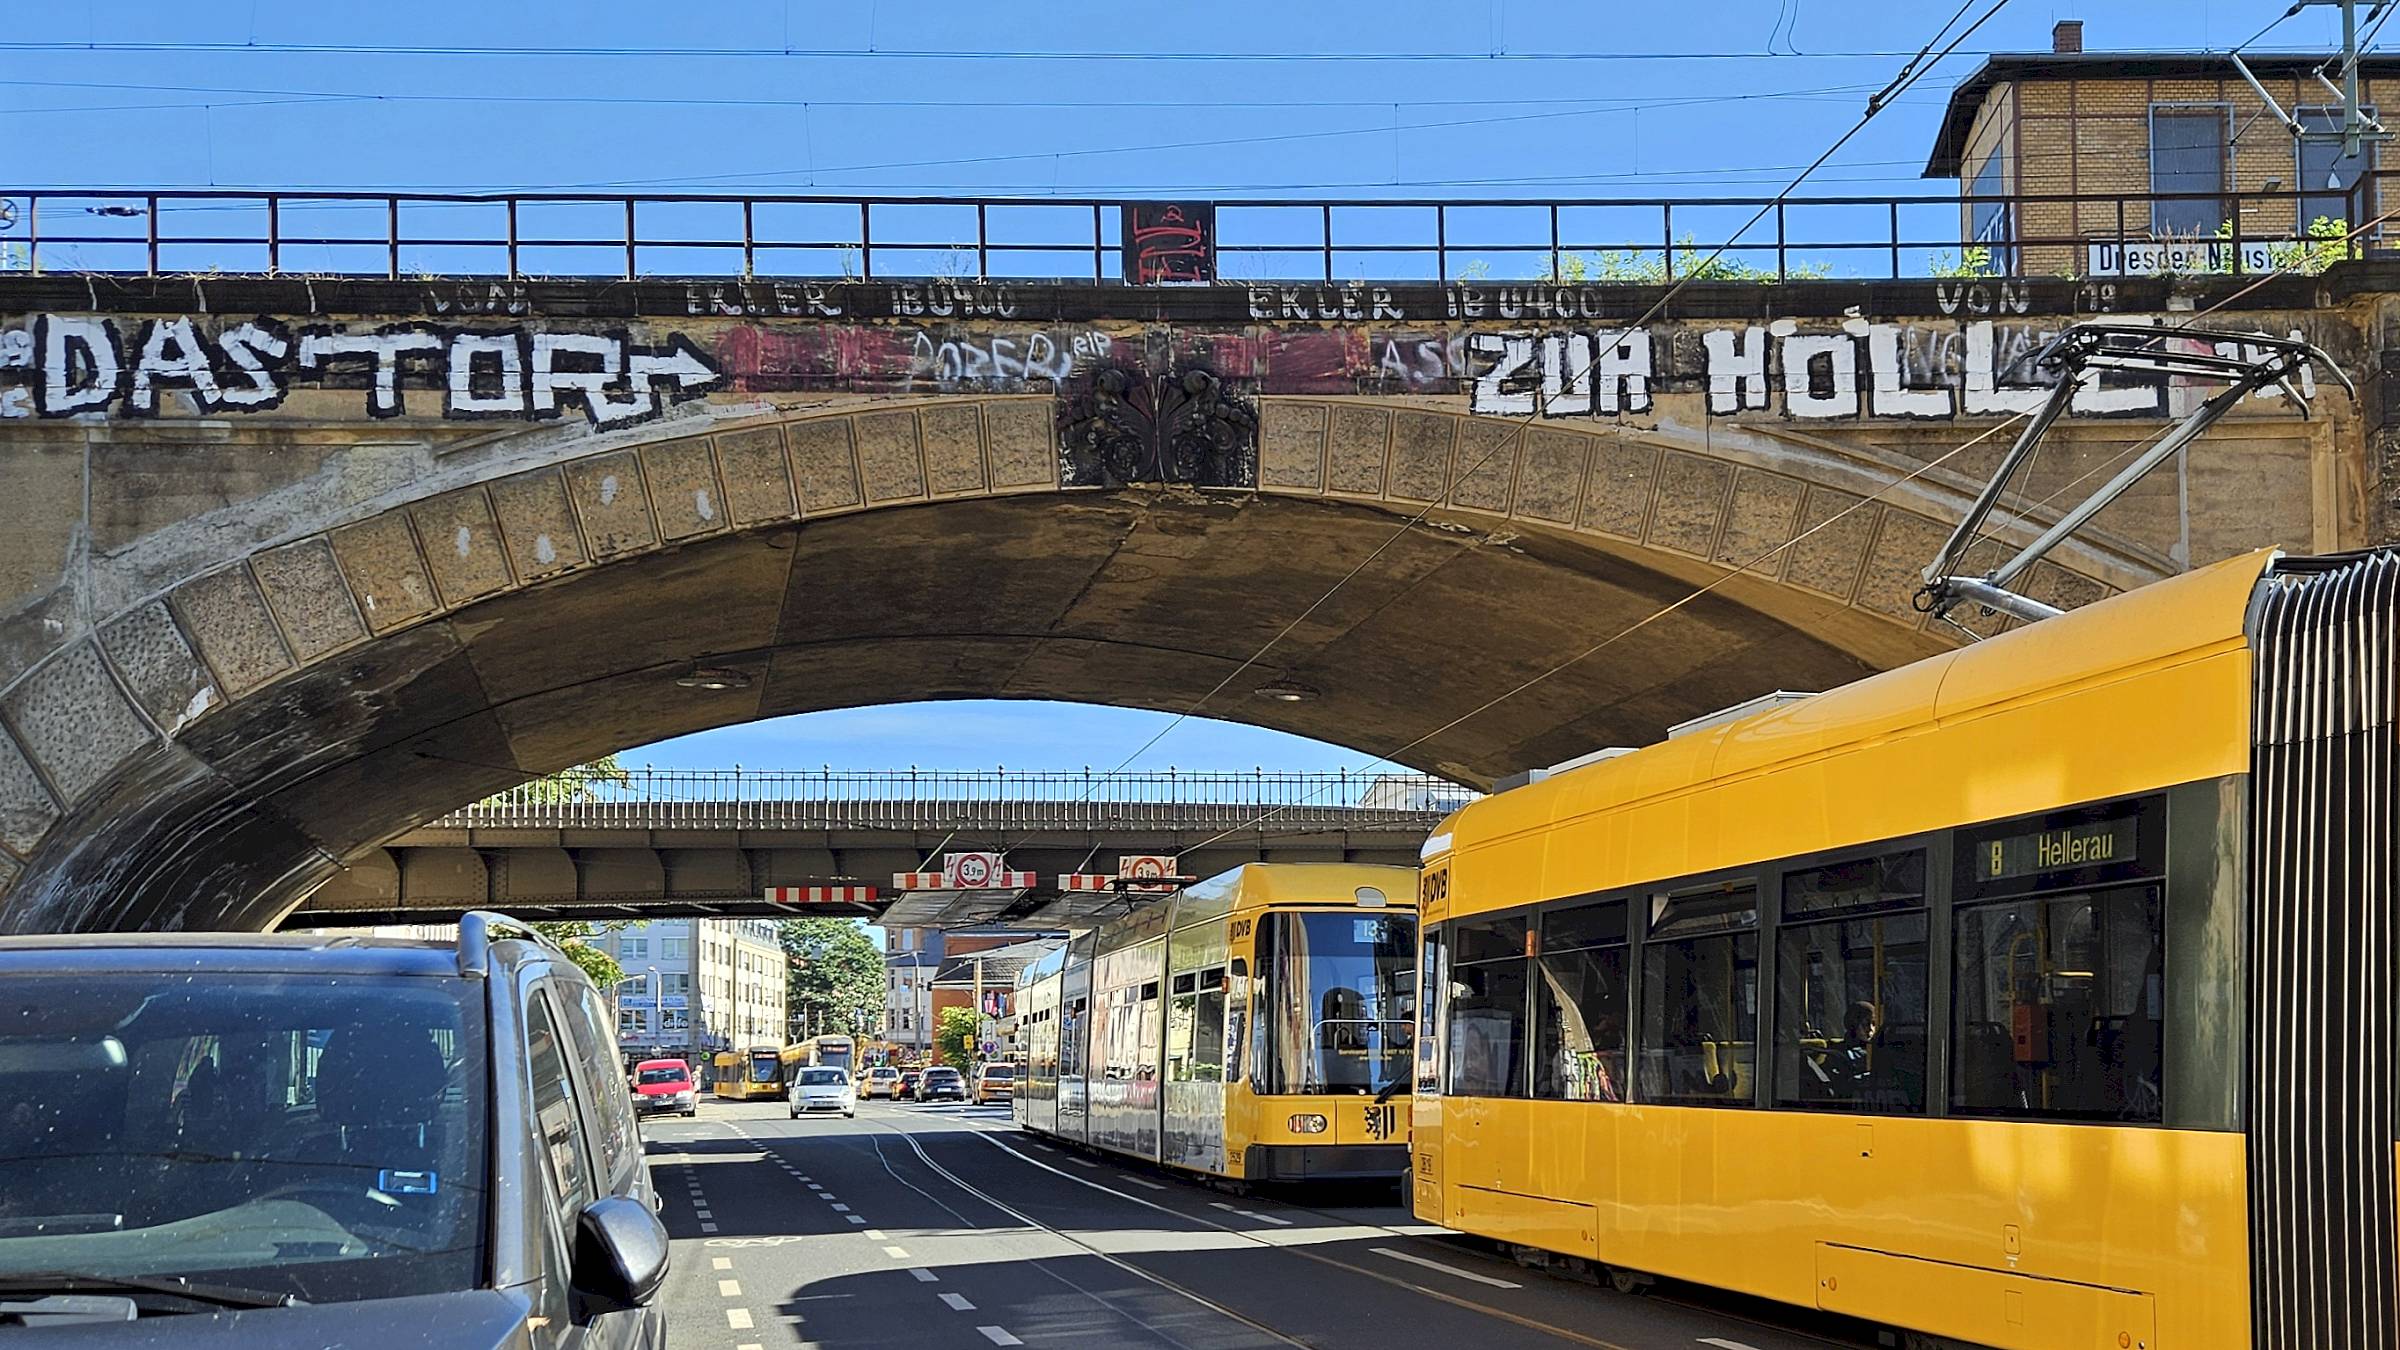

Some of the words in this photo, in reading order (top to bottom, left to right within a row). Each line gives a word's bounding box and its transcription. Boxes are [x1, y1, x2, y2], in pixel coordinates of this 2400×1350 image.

[1248, 286, 1404, 320] EKLER
[1936, 282, 2031, 314] VON
[35, 313, 289, 419] DAS
[299, 320, 661, 432] TOR
[1463, 327, 1656, 418] ZUR
[1991, 840, 2003, 876] 8
[2038, 831, 2113, 868] Hellerau
[1429, 868, 1448, 903] DVB
[1236, 919, 1252, 937] DVB
